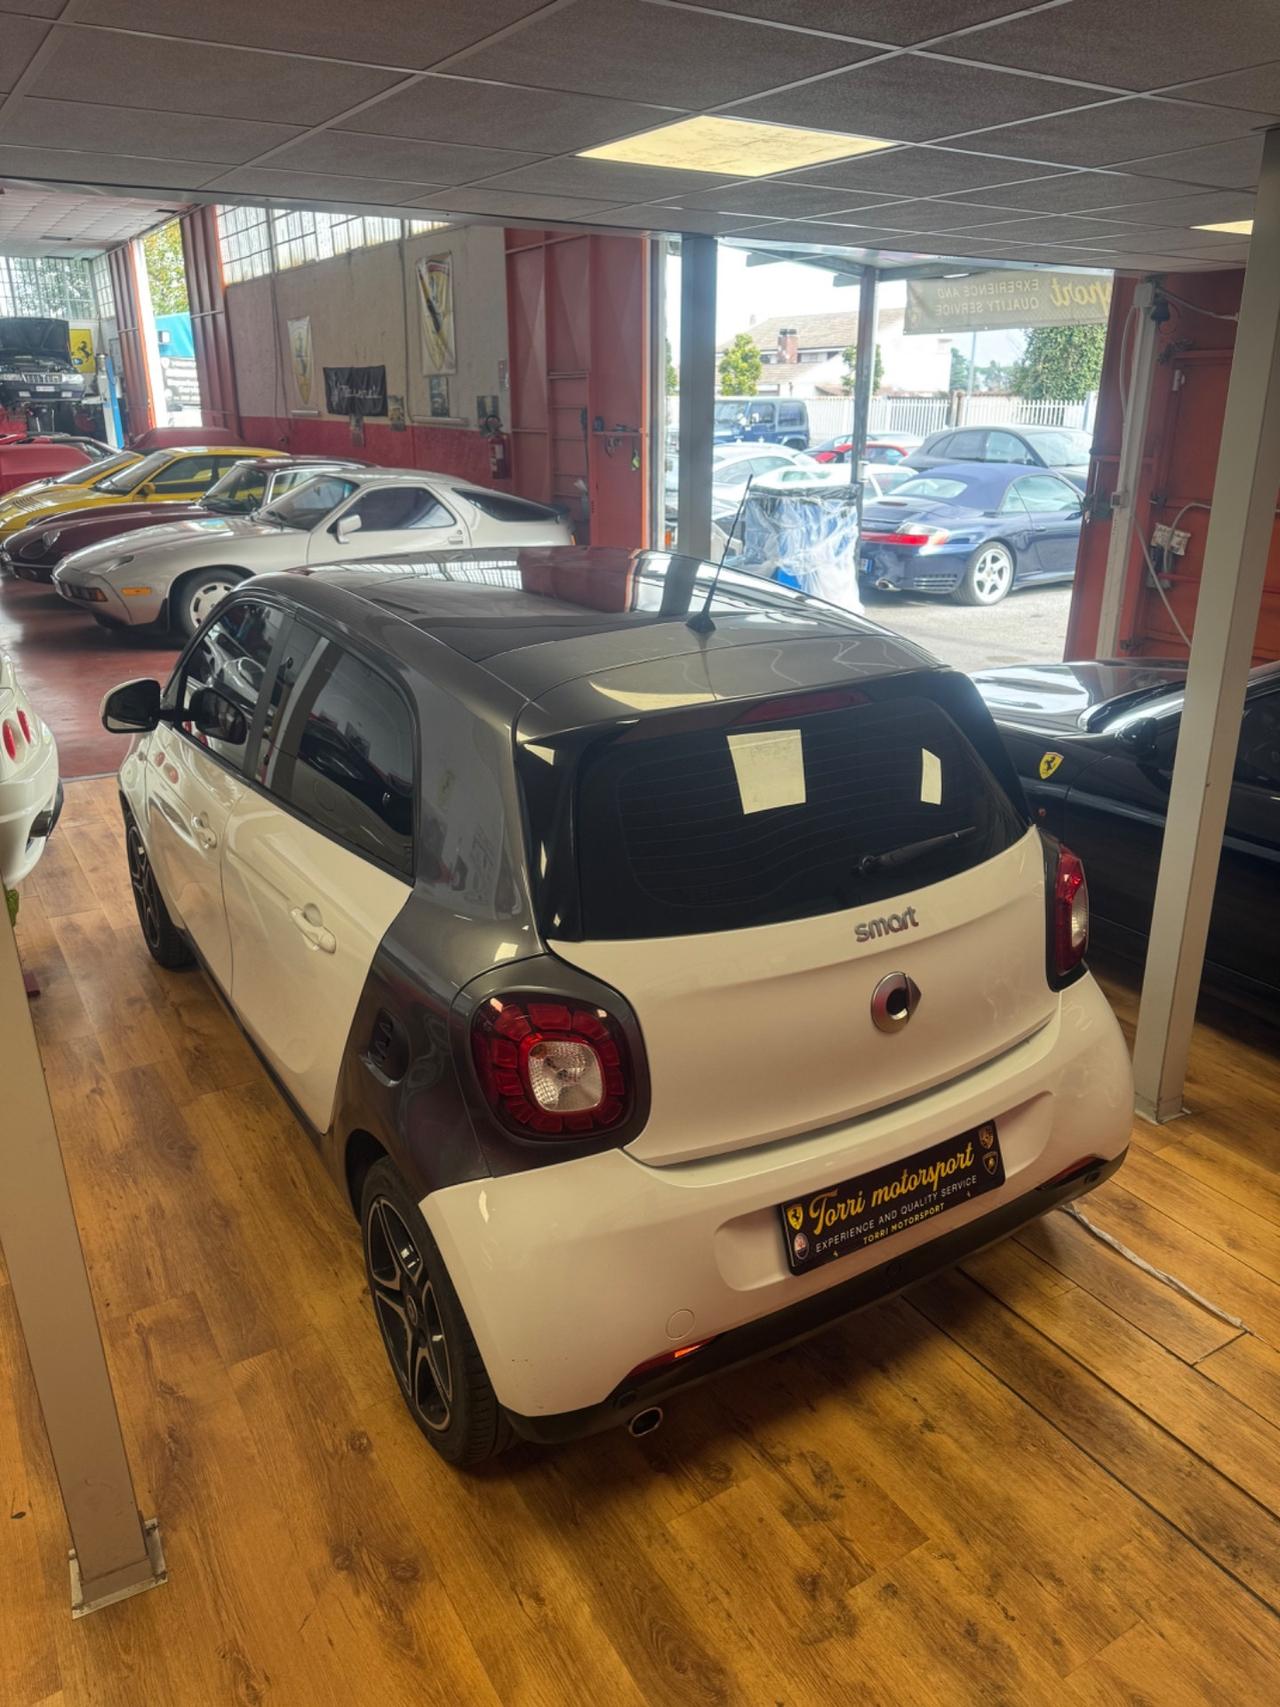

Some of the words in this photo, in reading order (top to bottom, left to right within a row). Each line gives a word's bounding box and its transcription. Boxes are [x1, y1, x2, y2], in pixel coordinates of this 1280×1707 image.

[854, 905, 920, 942] smart
[809, 1188, 866, 1235] Torri
[871, 1141, 975, 1207] motorsport
[815, 1220, 875, 1253] EXPERIENCE
[878, 1211, 898, 1225] AND
[900, 1191, 938, 1215] QUALITY
[941, 1174, 978, 1198] SERVICE
[863, 1228, 889, 1245] TORRI
[891, 1202, 945, 1232] MOTORSPORT
